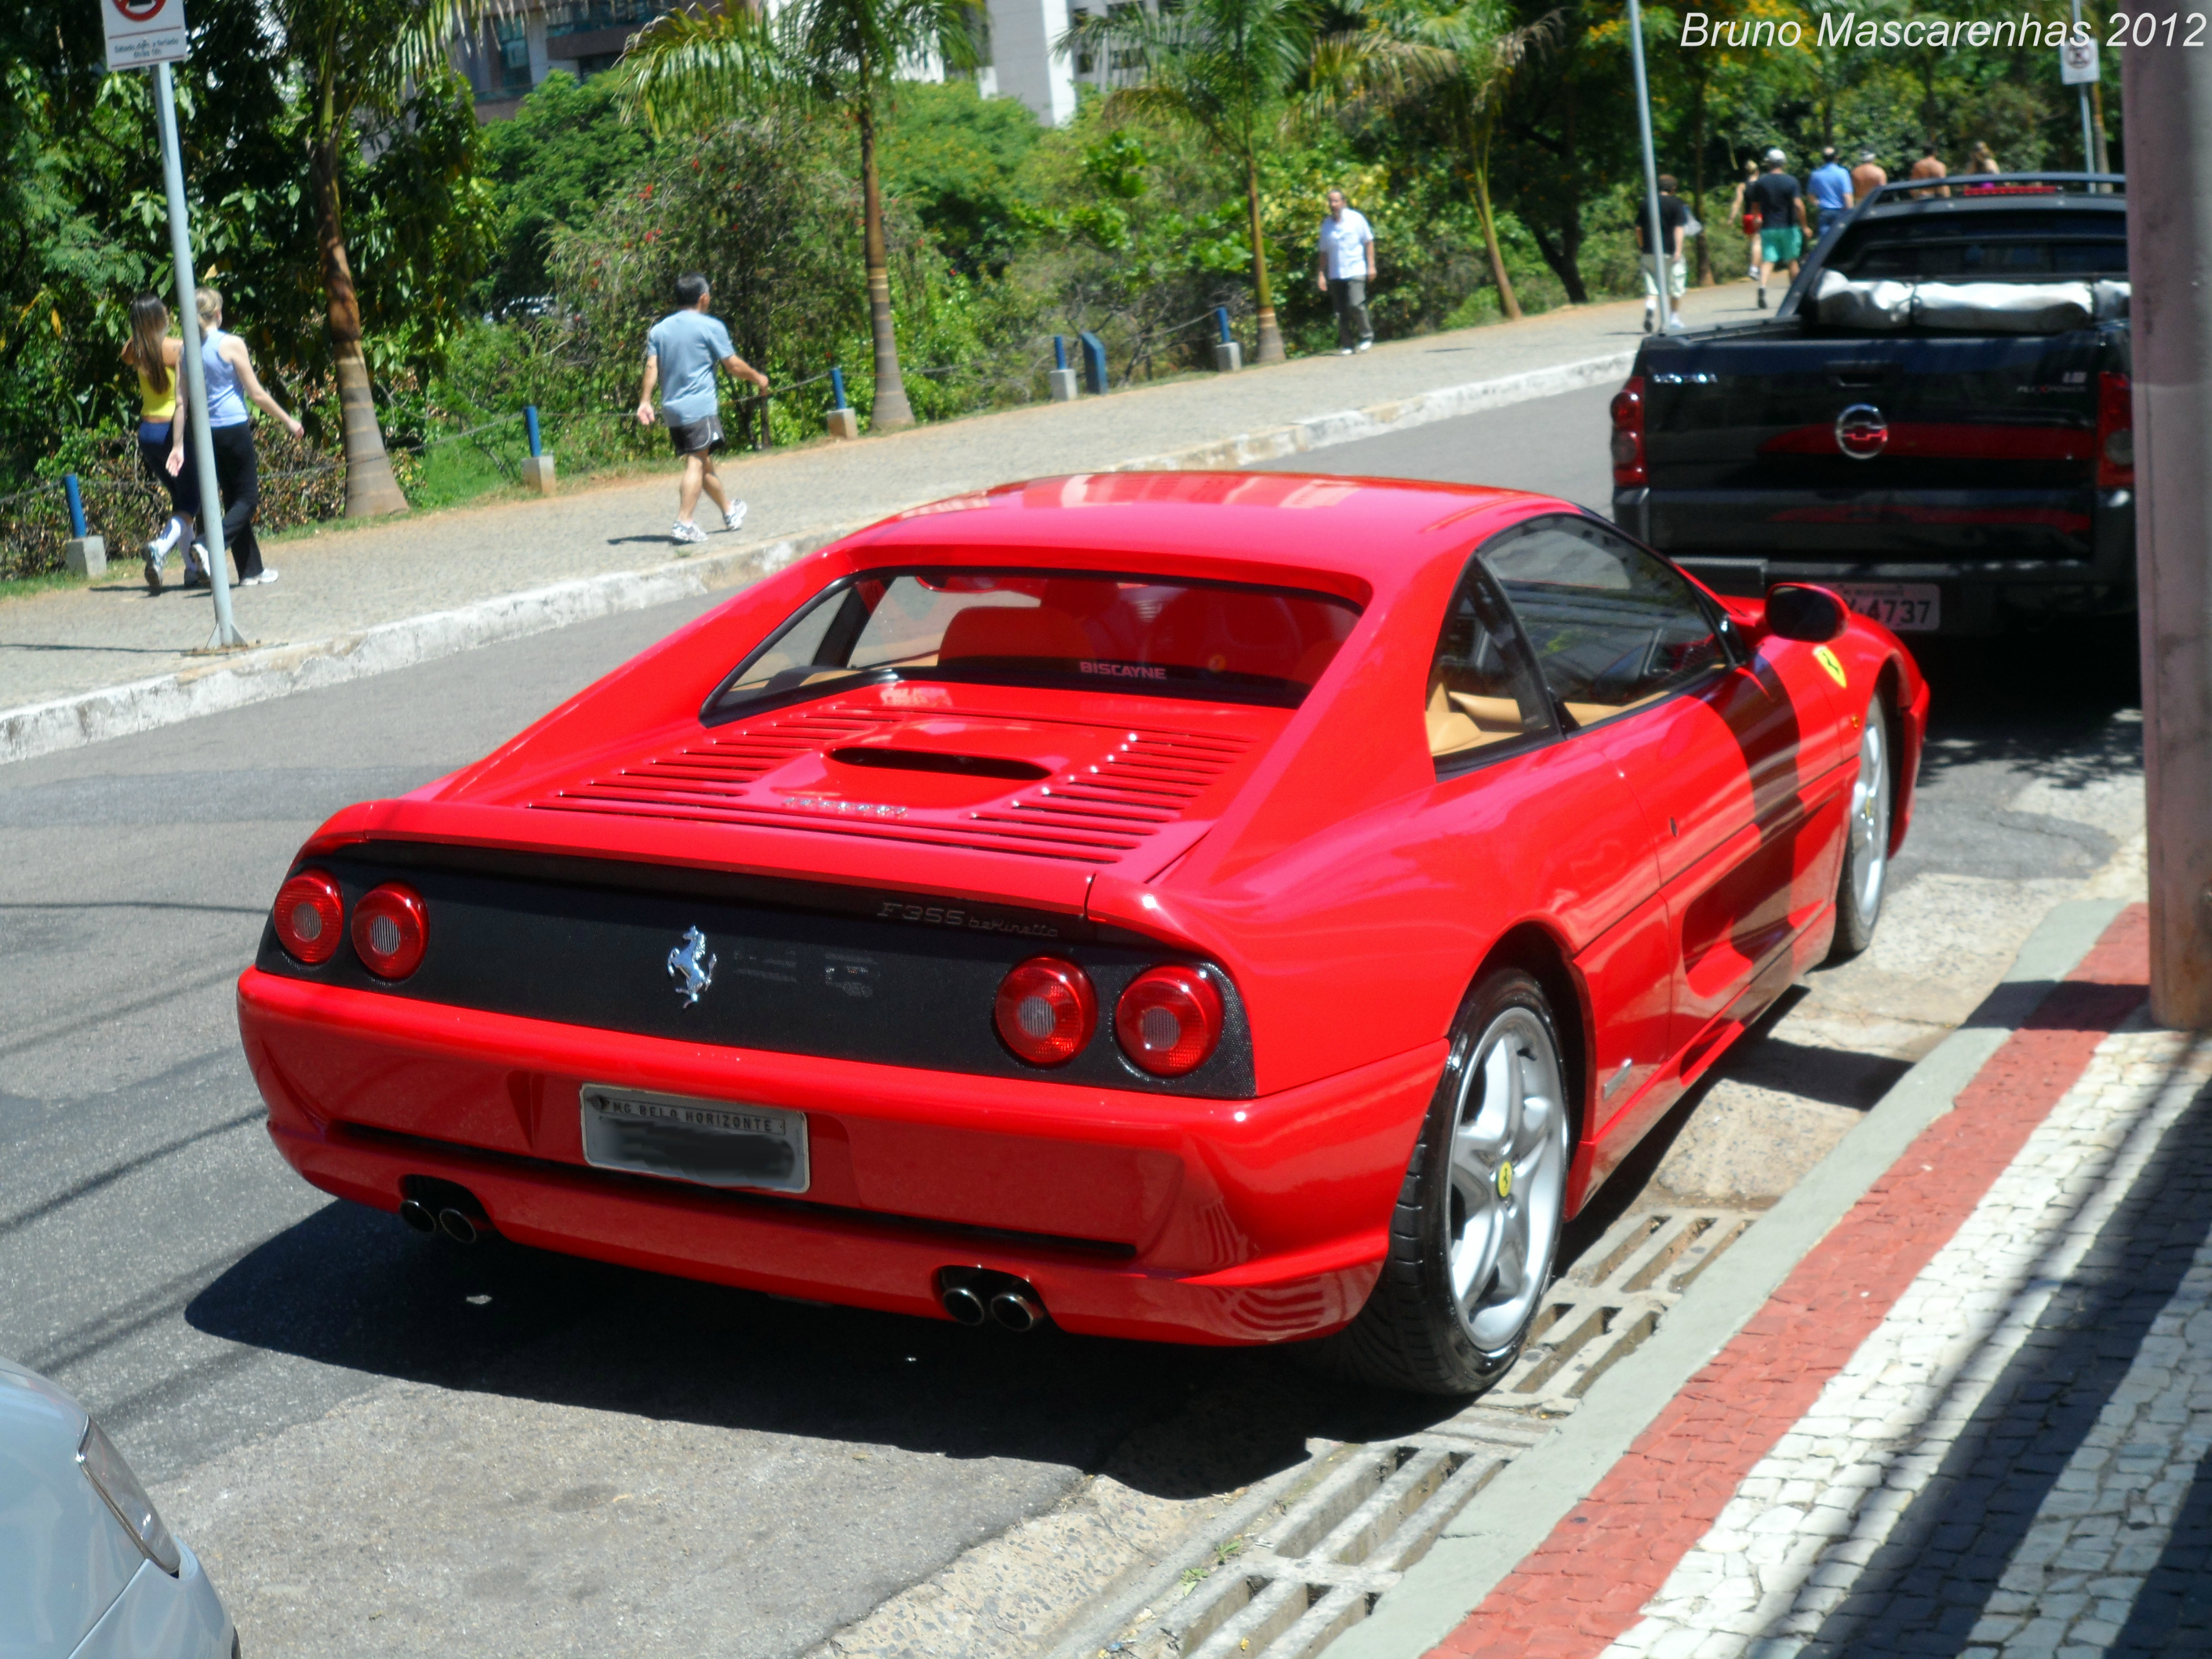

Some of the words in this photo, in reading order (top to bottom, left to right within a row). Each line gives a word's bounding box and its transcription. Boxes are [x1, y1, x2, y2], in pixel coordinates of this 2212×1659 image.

[1080, 661, 1166, 680] BISCAYNE
[877, 902, 966, 925] F355
[613, 1102, 632, 1114] MG
[685, 1112, 772, 1131] HORIZONTE
